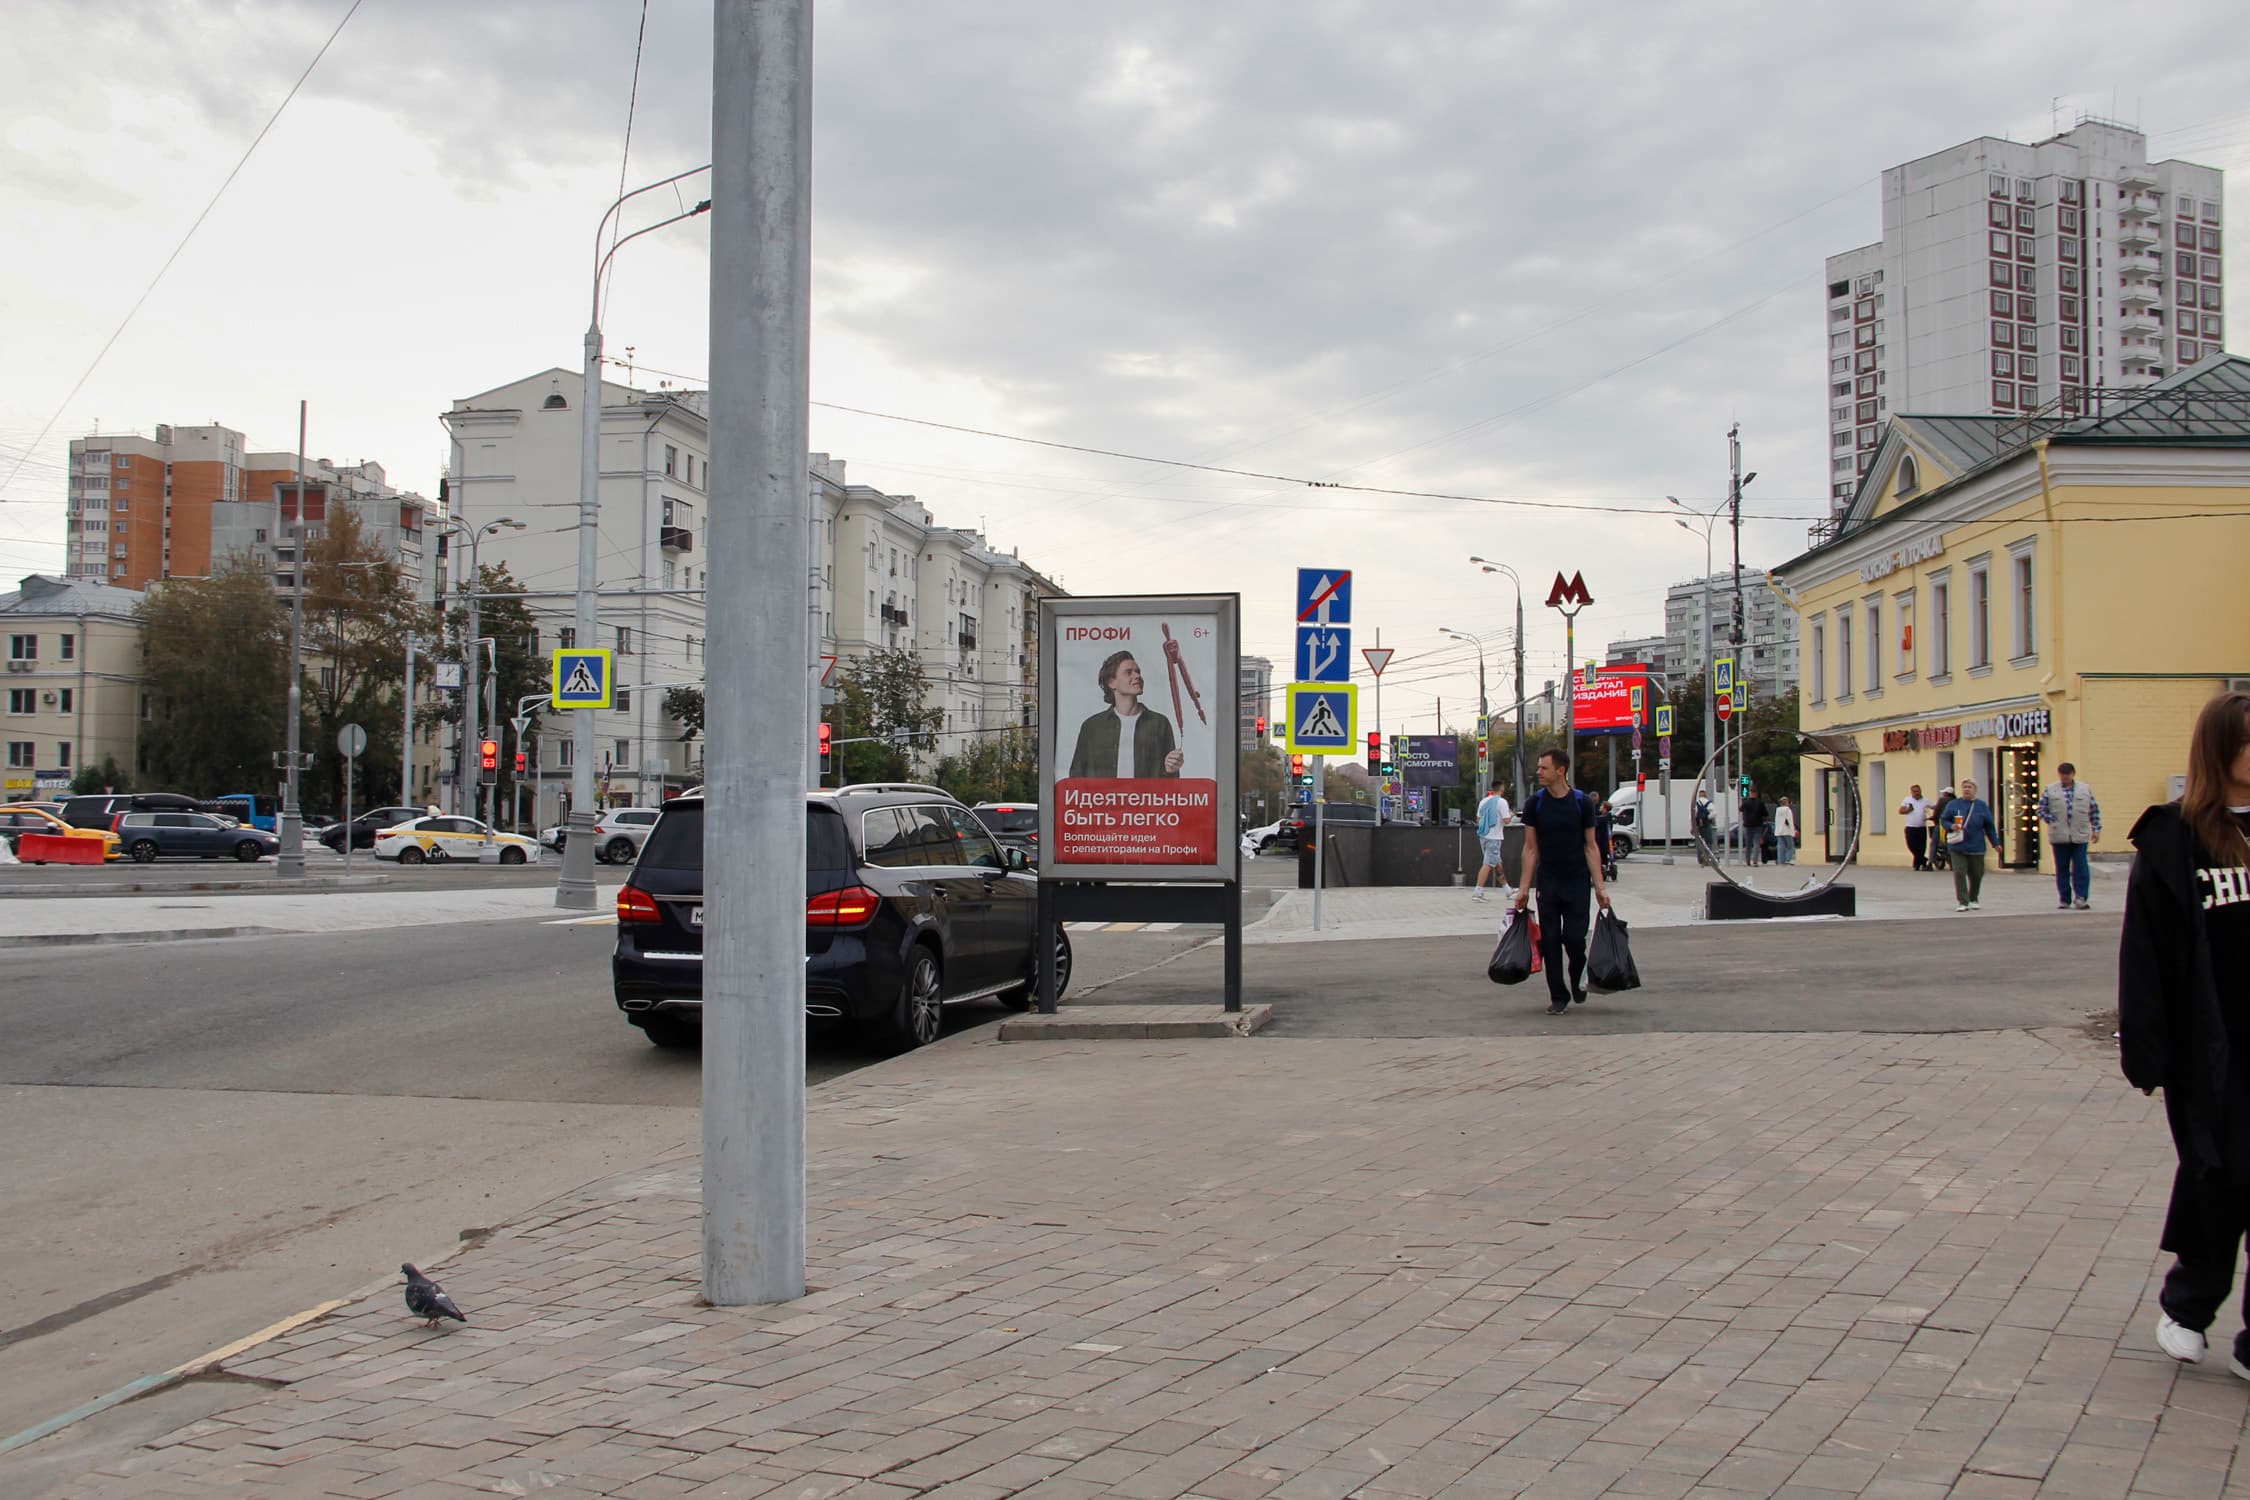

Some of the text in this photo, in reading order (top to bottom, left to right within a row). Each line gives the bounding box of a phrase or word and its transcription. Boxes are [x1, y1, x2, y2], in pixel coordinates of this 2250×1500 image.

[1066, 626, 1131, 640] ПРОФИ
[1193, 628, 1210, 638] 6+
[2007, 710, 2049, 736] COFFEE
[484, 758, 495, 768] 63
[37, 779, 74, 789] АПТЕК
[1065, 789, 1209, 808] Идеятельным
[1064, 809, 1179, 826] быть легко
[1064, 832, 1129, 842] Воплощайте
[1072, 845, 1146, 855] репетиторами
[1163, 845, 1197, 855] Профи
